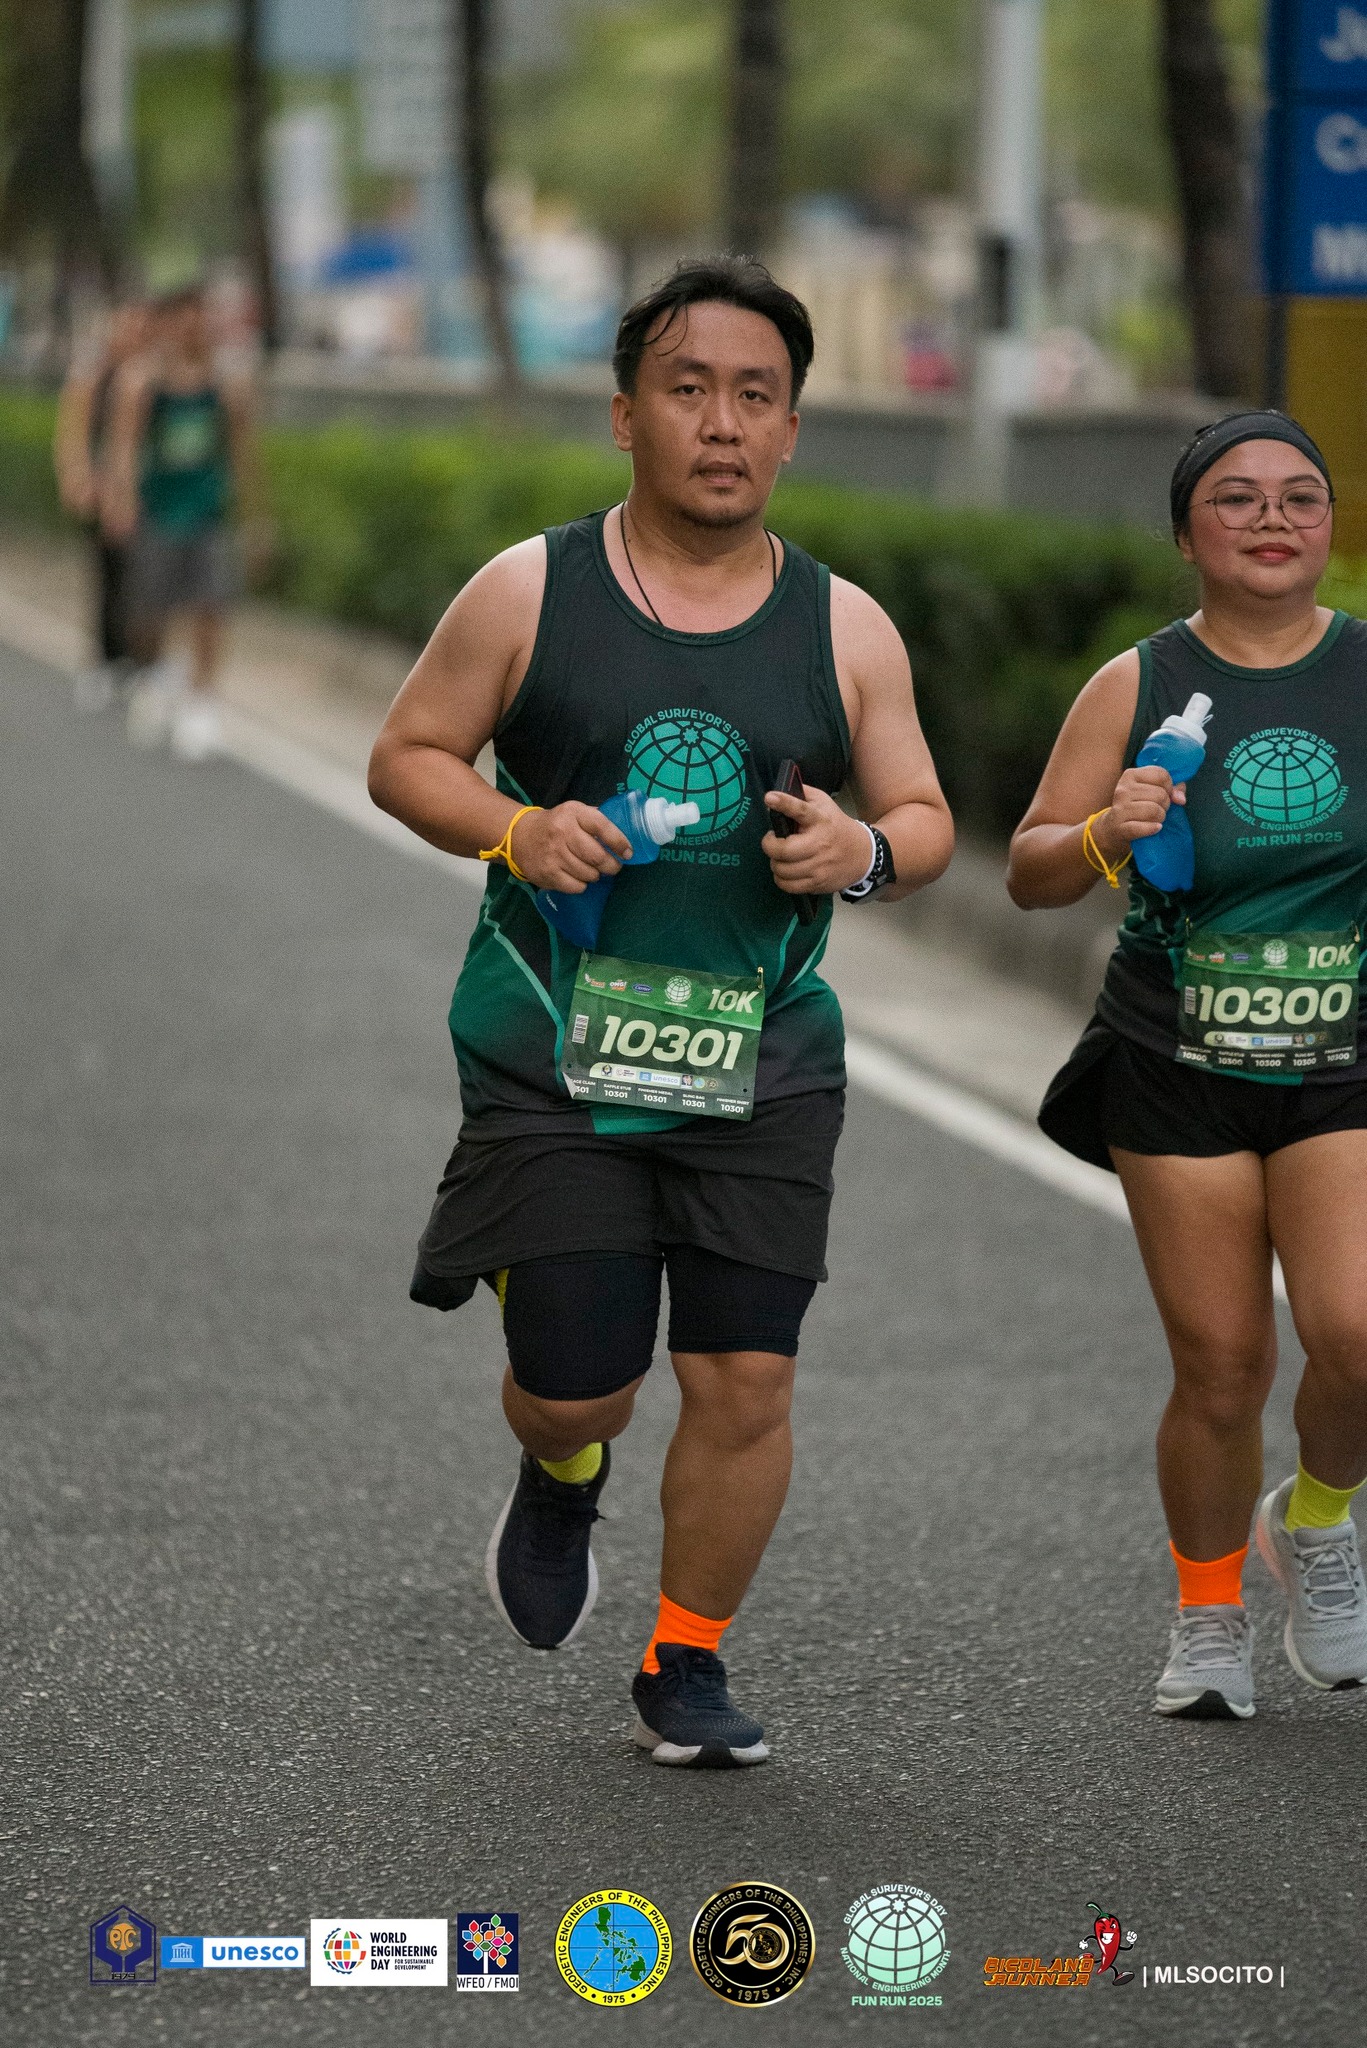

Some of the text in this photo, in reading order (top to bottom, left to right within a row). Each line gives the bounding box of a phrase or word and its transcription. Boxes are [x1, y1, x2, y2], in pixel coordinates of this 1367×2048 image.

[624, 708, 750, 753] GLOBAL SURVEYOR'S DAY
[1223, 727, 1338, 769] GLOBAL SURVEYOR'S DAY
[730, 796, 752, 832] MONTH
[1221, 785, 1349, 831] NATIONAL ENGINEERING MONTH
[1236, 831, 1343, 849] FUN RUN 2025
[659, 848, 741, 867] RUN 2025
[1308, 943, 1355, 969] 10K
[708, 988, 760, 1013] 10K
[1199, 983, 1353, 1025] 10300
[599, 1015, 743, 1071] 10301
[1183, 1051, 1207, 1062] 10300
[1218, 1057, 1244, 1066] 10300
[1293, 1057, 1317, 1067] 10300
[1327, 1052, 1350, 1062] 10300
[652, 1075, 679, 1084] unesco
[576, 1086, 589, 1094] 301
[604, 1090, 628, 1098] 10301
[643, 1095, 667, 1103] 10301
[682, 1099, 706, 1108] 10301
[721, 1104, 744, 1113] 10301
